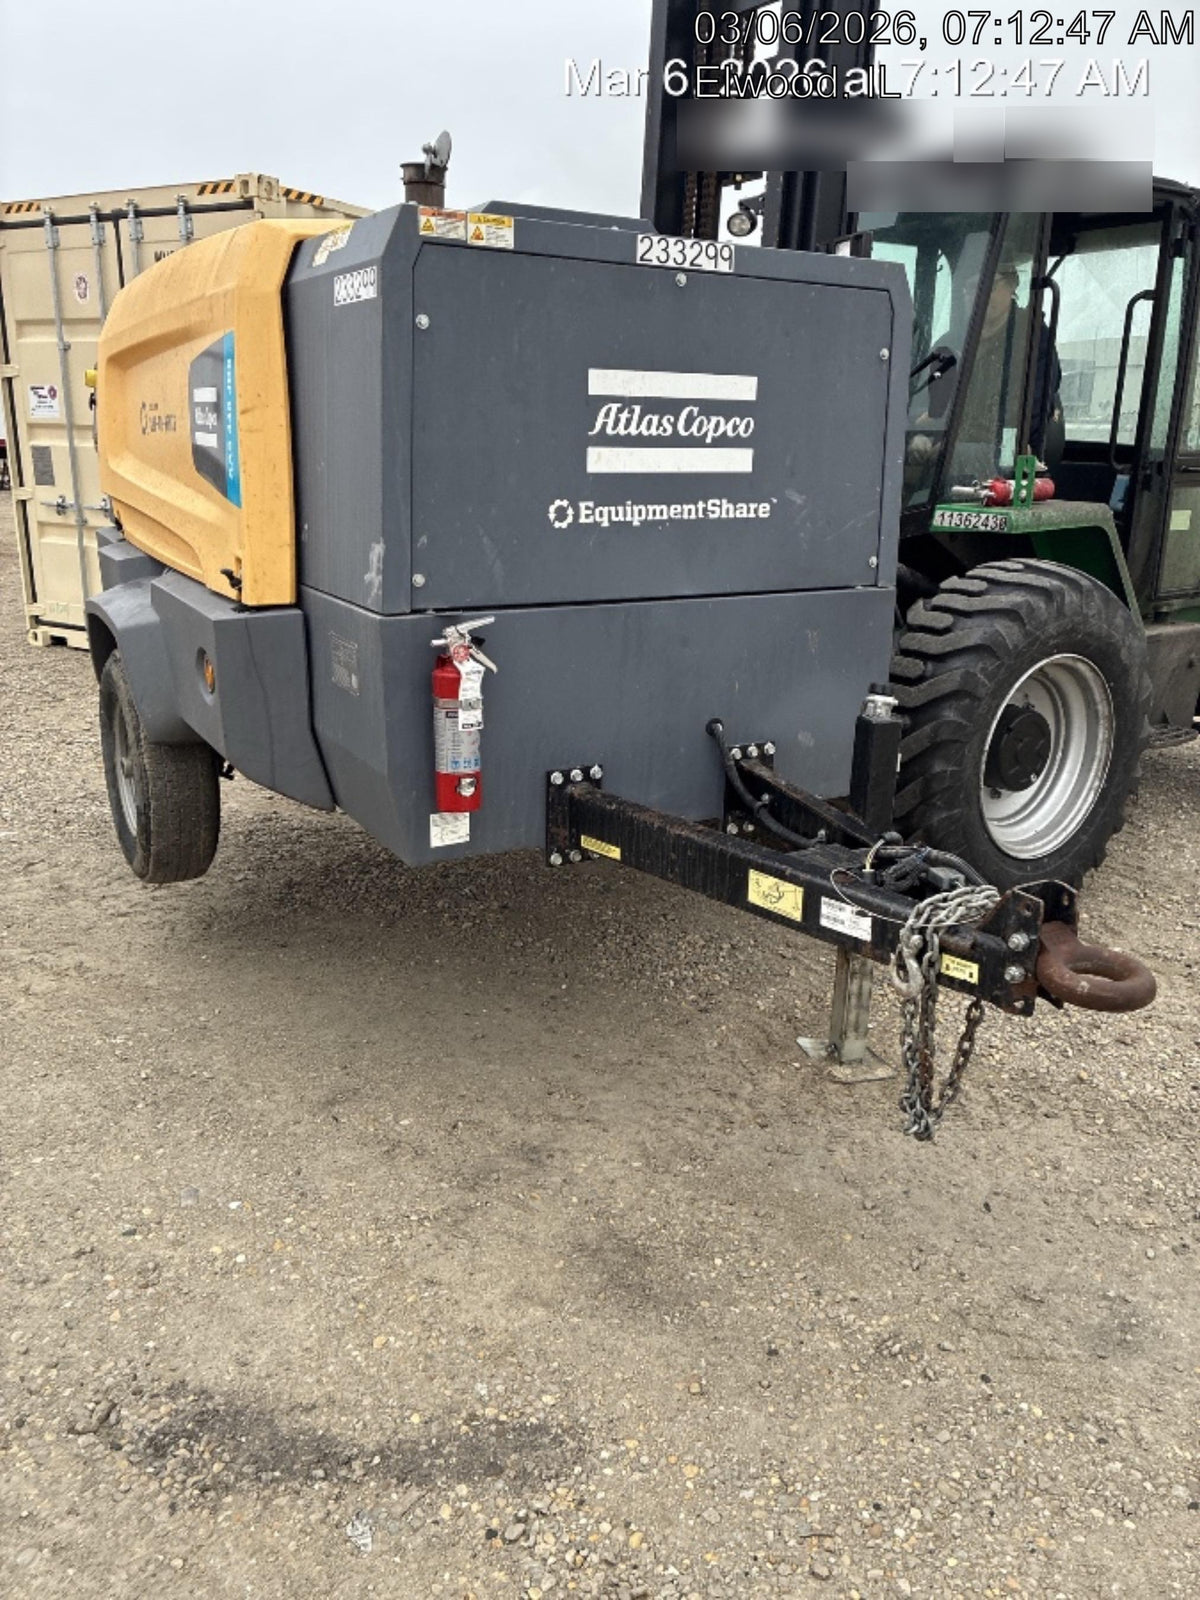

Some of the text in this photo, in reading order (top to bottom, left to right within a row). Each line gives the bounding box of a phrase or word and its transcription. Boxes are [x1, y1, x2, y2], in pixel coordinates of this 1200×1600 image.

[638, 235, 734, 270] 233299
[588, 402, 755, 443] Atlas Copco
[578, 499, 772, 526] EquipmentShare
